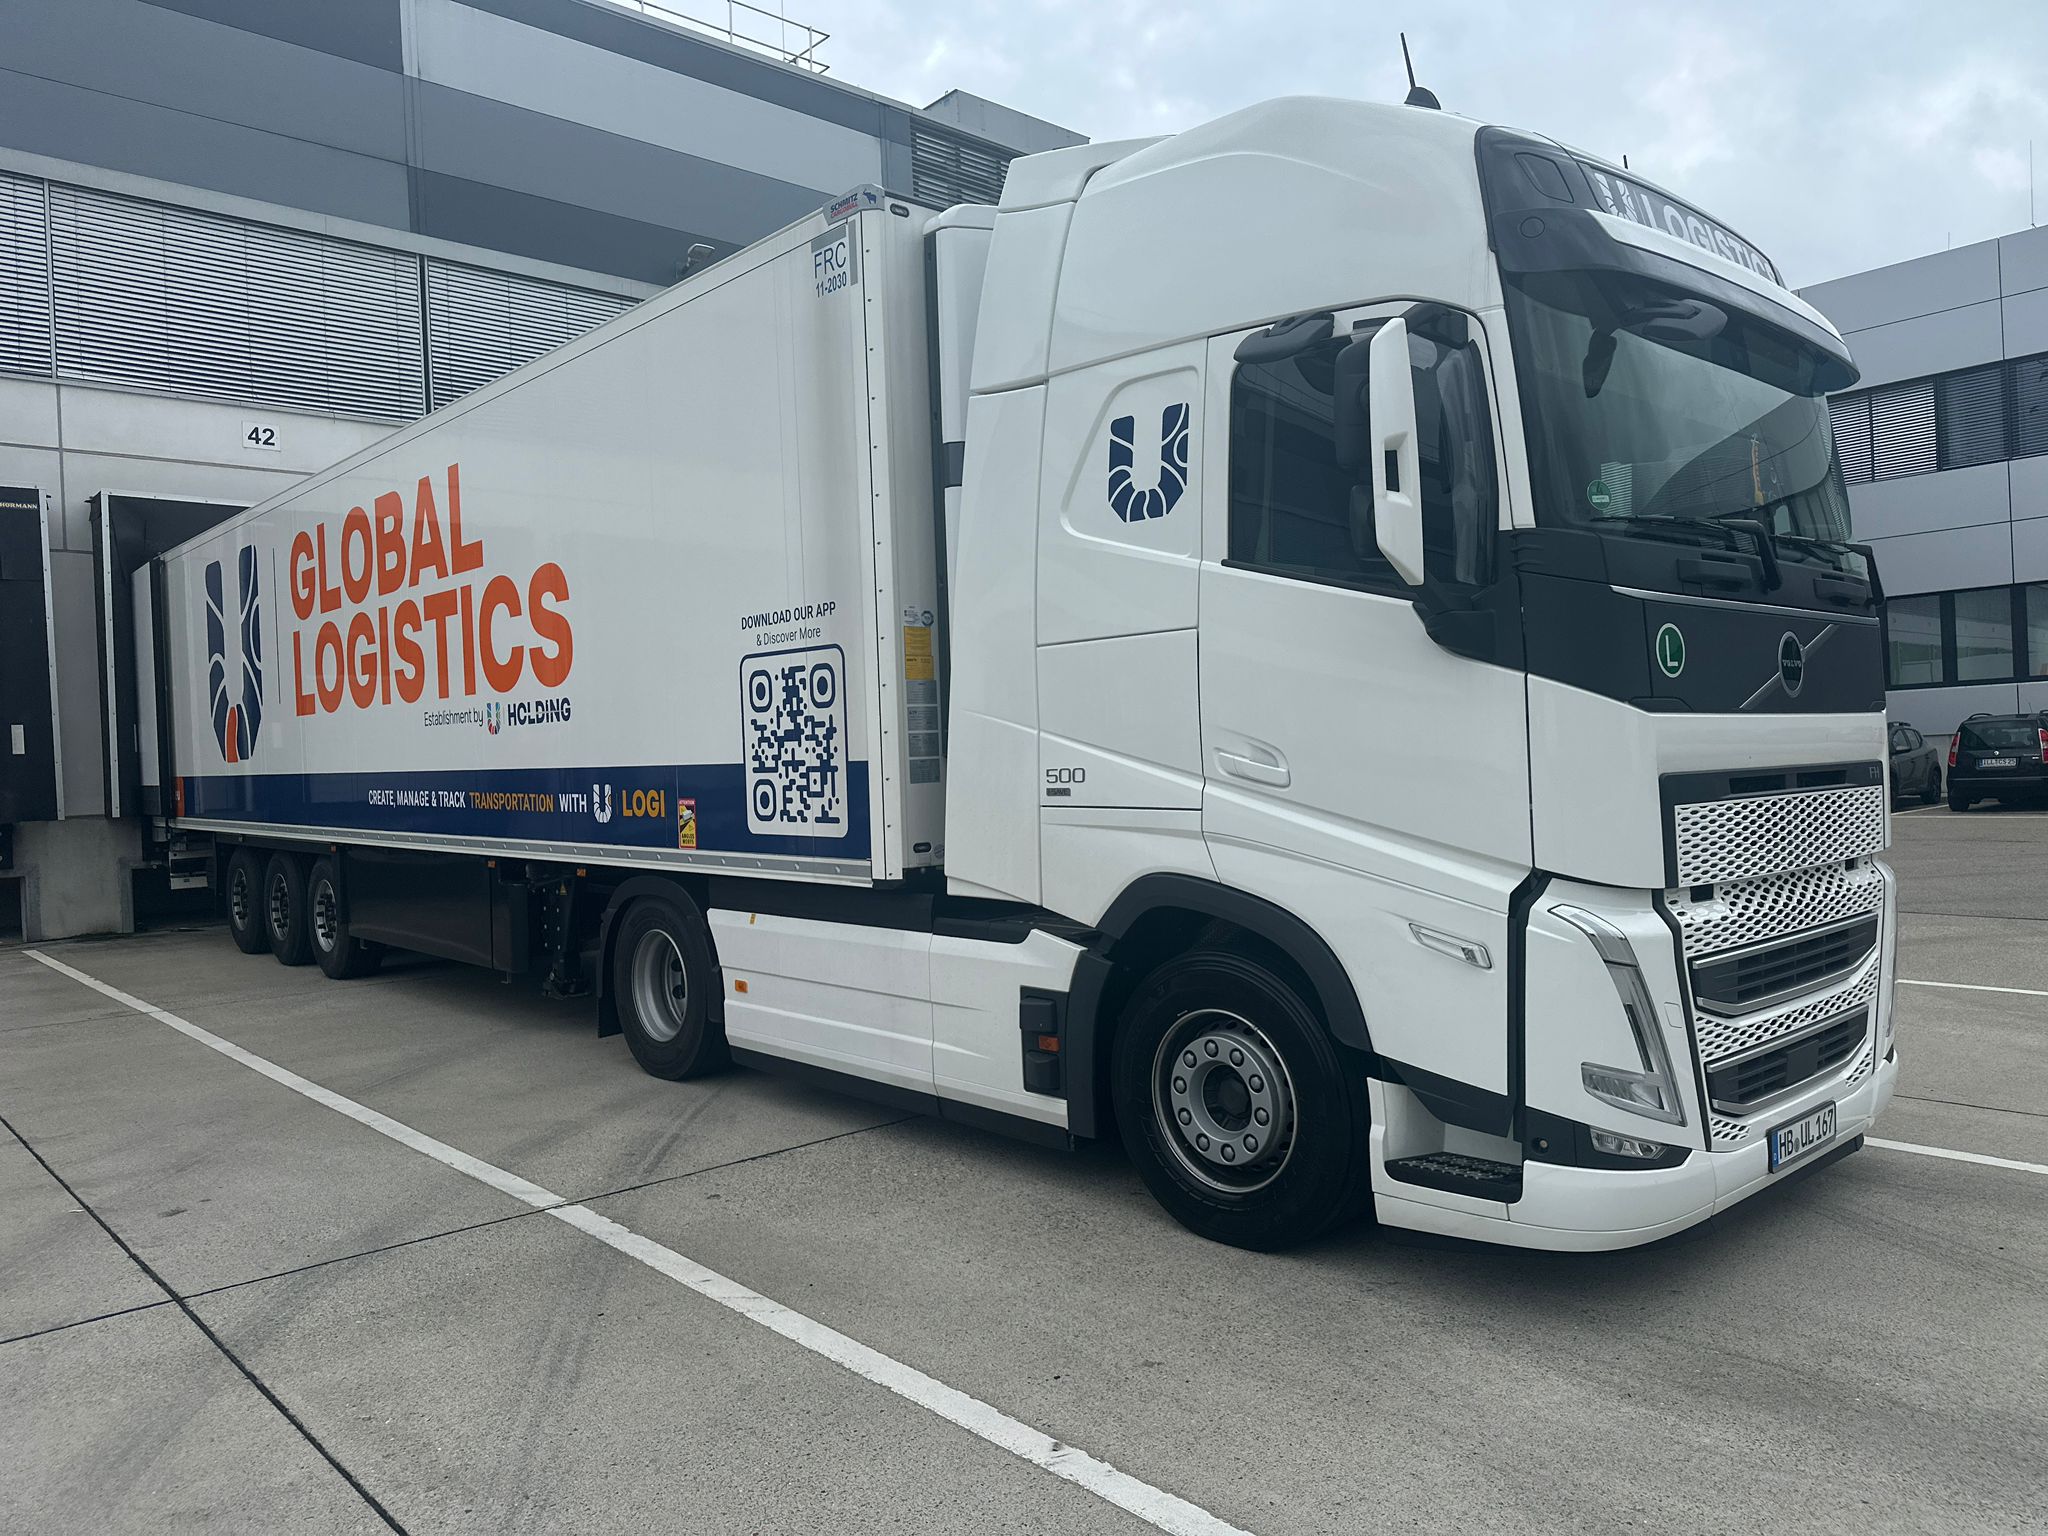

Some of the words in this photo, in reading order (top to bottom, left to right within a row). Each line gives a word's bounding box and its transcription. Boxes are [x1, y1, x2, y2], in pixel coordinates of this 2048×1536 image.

[814, 241, 847, 279] FRC
[815, 271, 847, 298] 11-2030
[247, 426, 276, 447] 42
[290, 462, 484, 621] GLOBAL
[741, 609, 792, 630] DOWNLOAD
[793, 604, 813, 621] OUR
[816, 601, 836, 618] APP
[293, 562, 574, 717] LOGISTICS
[756, 633, 762, 647] &
[763, 629, 797, 646] Discover
[799, 626, 821, 640] More
[1665, 634, 1679, 667] L
[1782, 659, 1802, 668] VOLVO
[424, 708, 472, 727] Establishment
[473, 707, 484, 727] by
[507, 697, 571, 726] HOLDING
[1046, 767, 1086, 783] 500
[368, 790, 396, 808] CREATE,
[397, 790, 429, 807] MANAGE
[431, 791, 437, 807] &
[438, 791, 466, 808] TRACK
[469, 791, 554, 813] TRANSPORTATION
[558, 793, 587, 813] WITH
[622, 789, 666, 818] LOGI
[1779, 1129, 1794, 1159] HB
[1801, 1120, 1815, 1148] UL
[1816, 1108, 1834, 1141] 167
